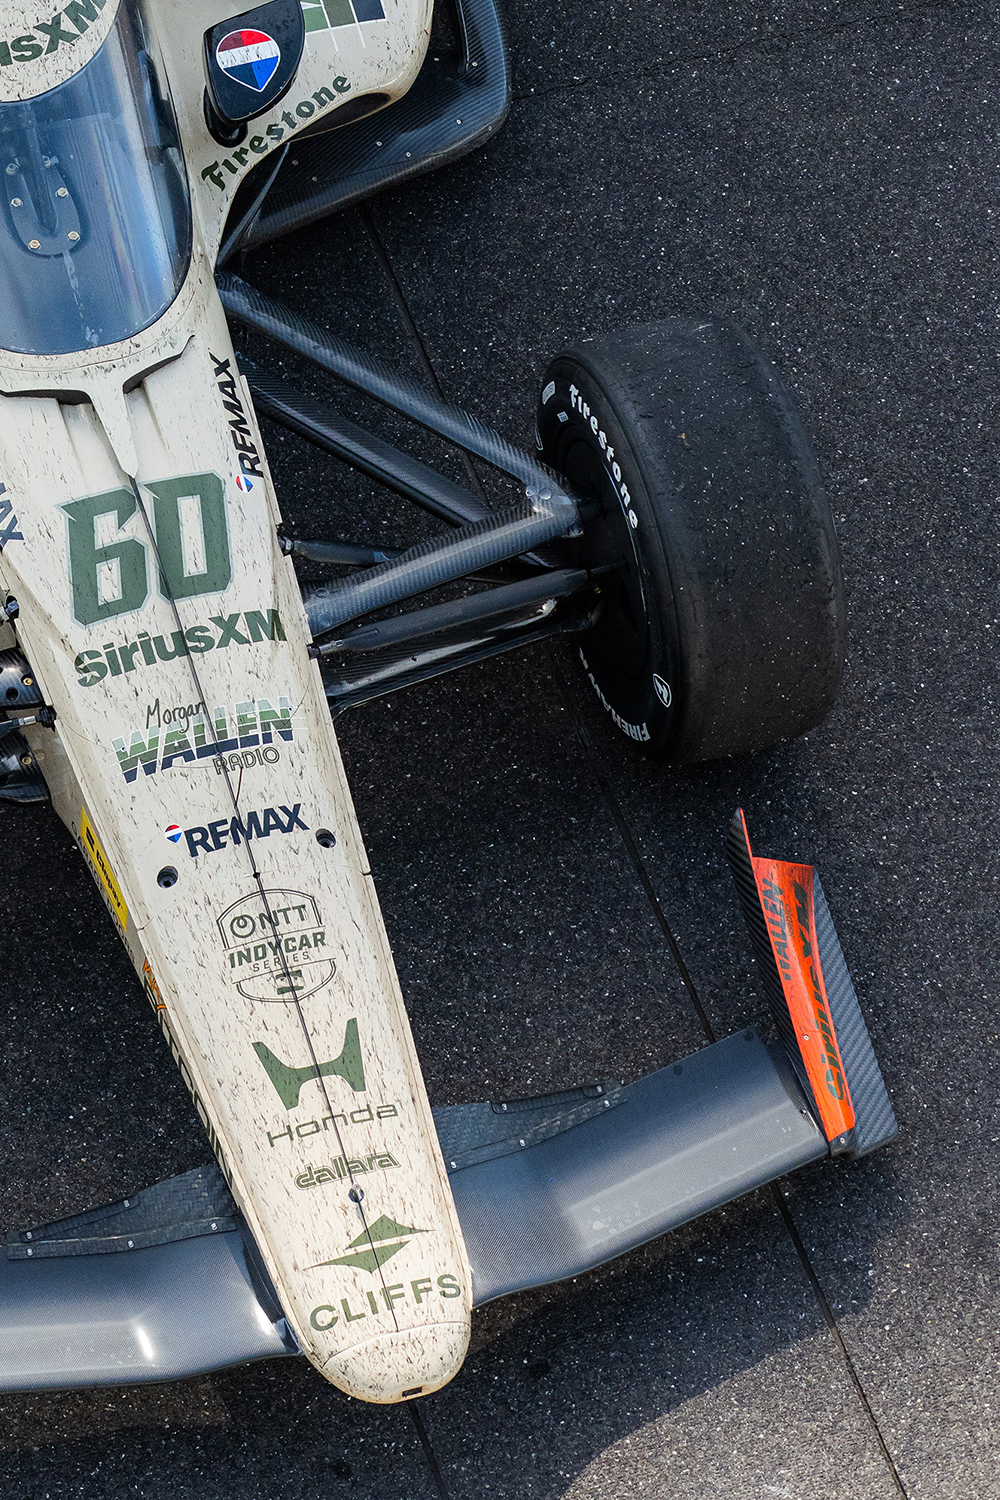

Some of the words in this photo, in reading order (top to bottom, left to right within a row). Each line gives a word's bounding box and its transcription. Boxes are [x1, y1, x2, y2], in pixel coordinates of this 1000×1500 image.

[200, 72, 352, 193] Firestone
[212, 352, 265, 479] REMAX
[568, 383, 639, 531] Firestone
[54, 469, 237, 631] 60
[74, 608, 288, 688] SiriusXM
[111, 695, 299, 784] WALLEN
[145, 697, 207, 733] Morgan
[213, 746, 281, 776] RADIO
[182, 803, 310, 858] REMAX
[95, 846, 123, 909] Clopay
[258, 904, 309, 930] NTT
[228, 930, 327, 969] INDYCAR
[252, 950, 312, 973] SERIES
[794, 879, 851, 1107] SiriusXM
[265, 1100, 399, 1148] Honda
[295, 1150, 400, 1190] dallara
[308, 1272, 462, 1334] CLIFFS
